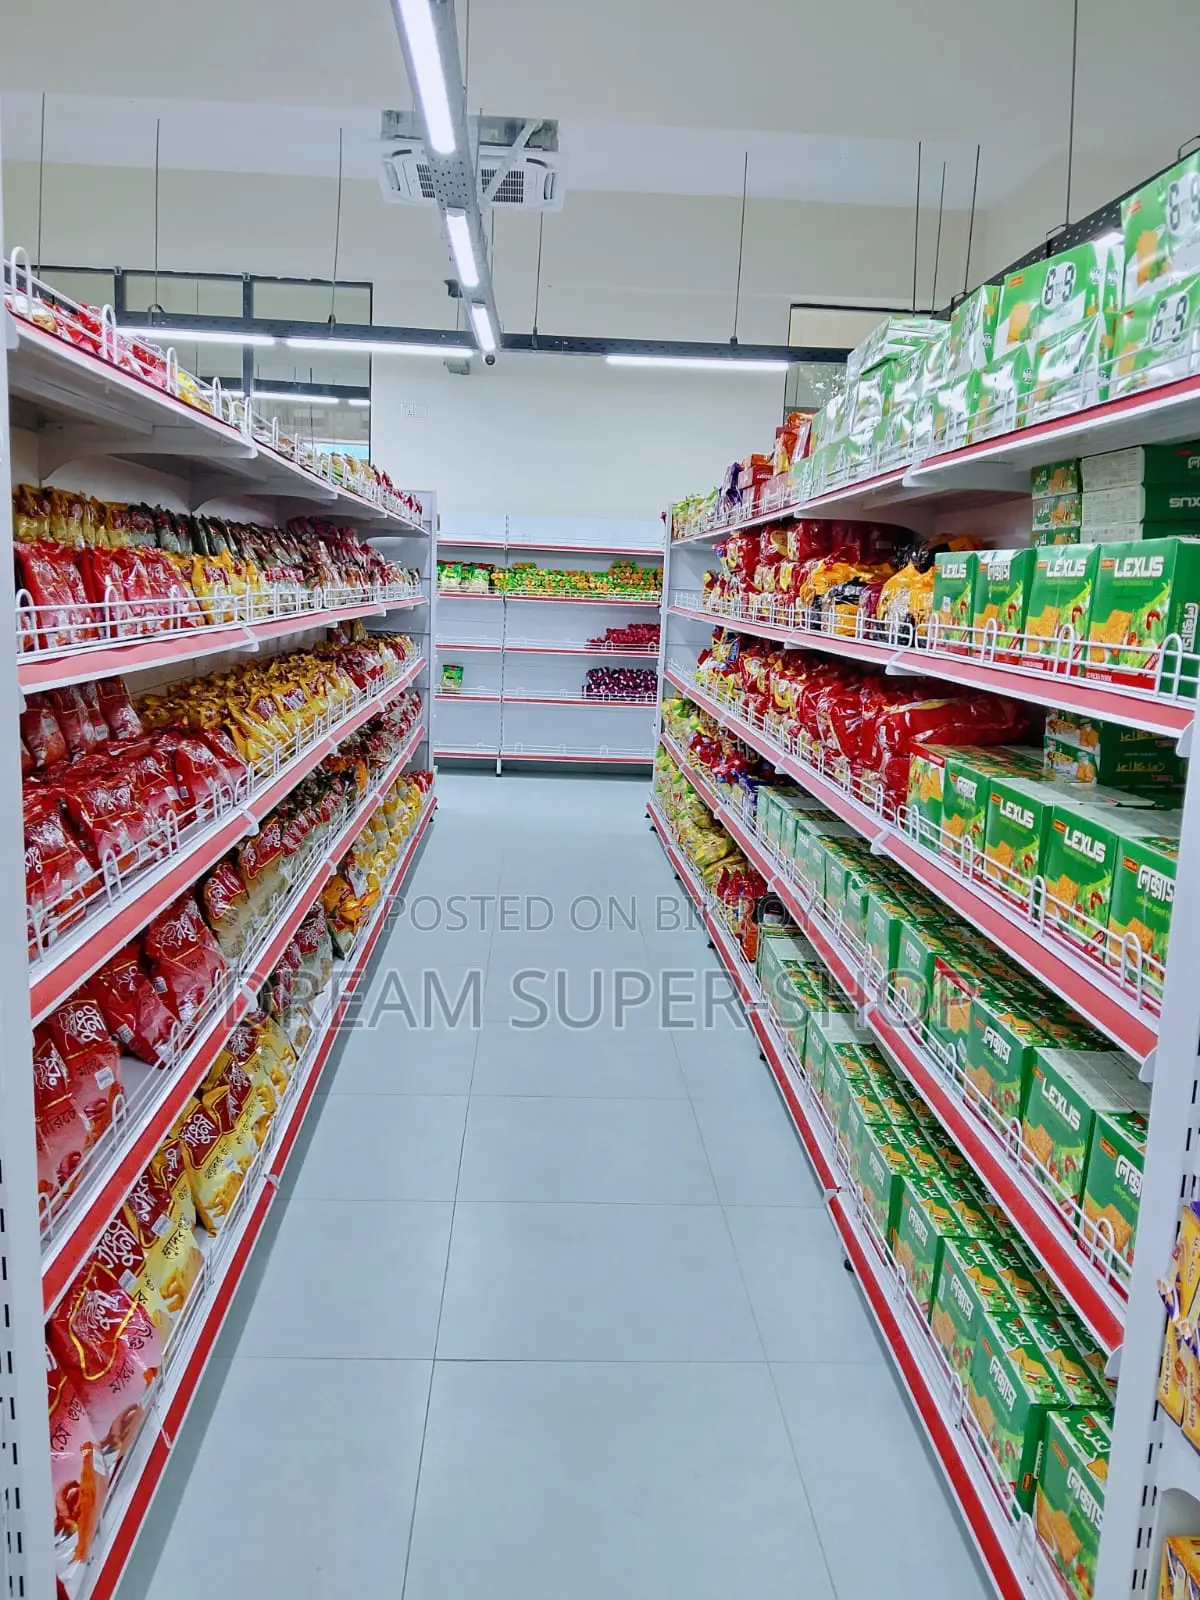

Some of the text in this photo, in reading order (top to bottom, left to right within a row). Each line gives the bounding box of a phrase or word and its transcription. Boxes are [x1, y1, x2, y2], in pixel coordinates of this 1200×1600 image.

[1045, 558, 1087, 577] LEXUS
[1113, 555, 1164, 578] LEXUS
[1000, 797, 1035, 830] LEXUS
[1063, 826, 1106, 864] LEXUS
[1041, 1077, 1081, 1131] LEXUS
